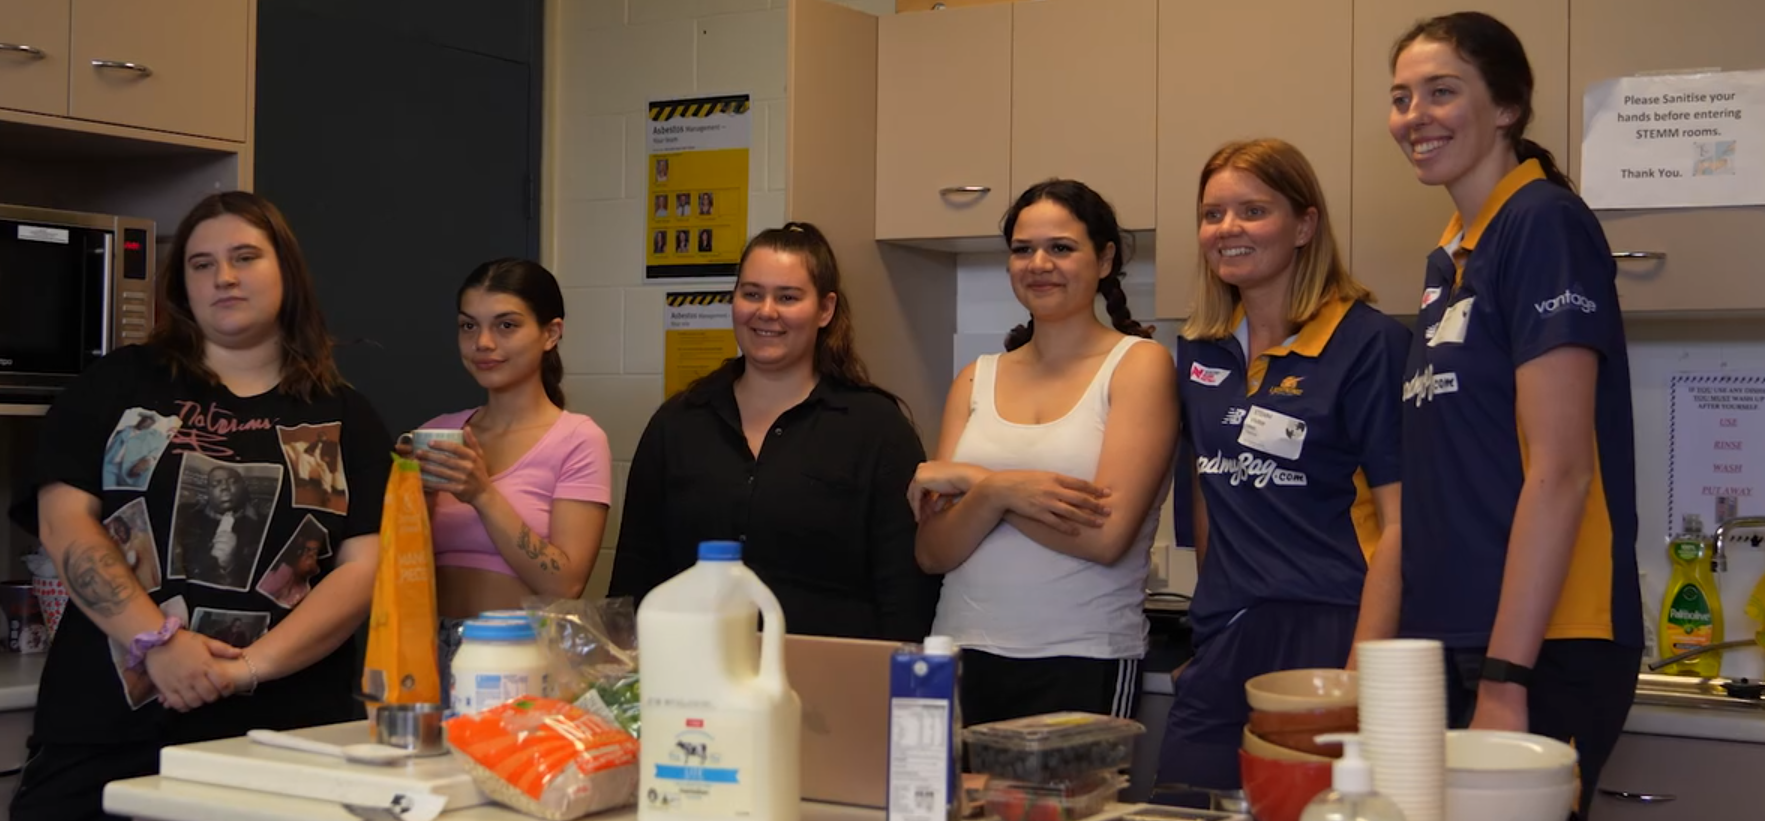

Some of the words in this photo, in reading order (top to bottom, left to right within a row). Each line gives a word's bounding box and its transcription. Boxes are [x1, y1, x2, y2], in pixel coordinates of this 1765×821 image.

[1624, 94, 1660, 106] Please
[1662, 93, 1707, 105] Sanitise
[1709, 92, 1736, 104] your
[1618, 111, 1651, 122] hands
[1654, 110, 1690, 122] before
[1692, 108, 1742, 121] entering
[652, 126, 685, 137] Asbestos
[1636, 128, 1679, 139] STEMM
[1682, 126, 1721, 137] rooms.
[1620, 169, 1655, 179] Thank
[1657, 168, 1683, 179] You.
[1534, 289, 1597, 313] vantage
[1719, 418, 1738, 427] USE
[1713, 441, 1743, 450] RINSE
[1713, 464, 1743, 473] WASH
[1701, 486, 1721, 496] PUT
[1722, 486, 1753, 496] AWAY
